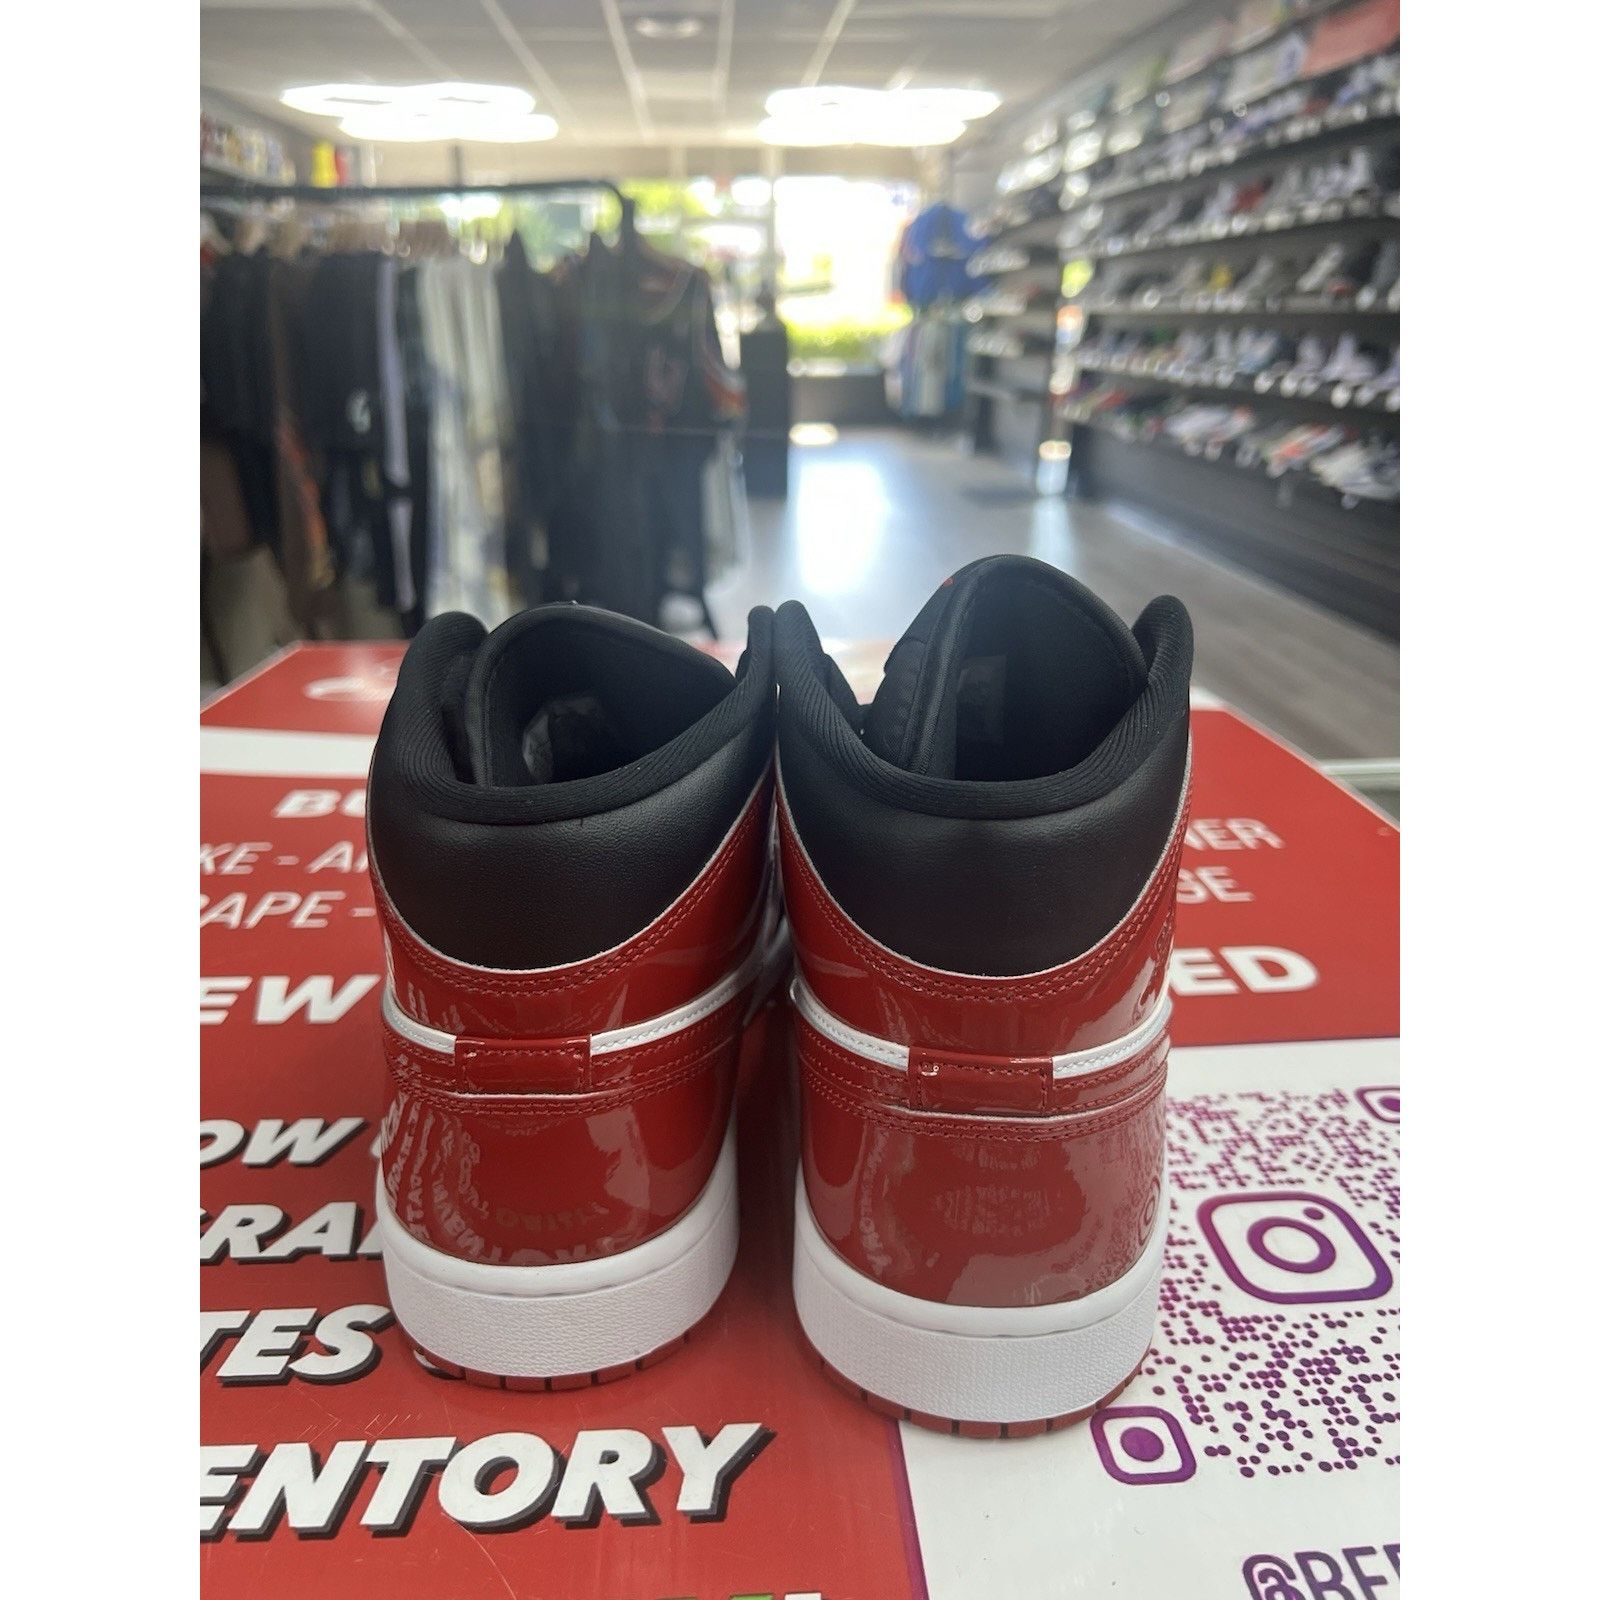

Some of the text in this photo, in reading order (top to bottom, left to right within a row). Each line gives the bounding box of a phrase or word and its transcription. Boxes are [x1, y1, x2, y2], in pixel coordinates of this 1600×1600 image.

[306, 840, 368, 873] A
[200, 890, 346, 930] APE
[1170, 946, 1320, 996] ED
[200, 974, 381, 1025] EW
